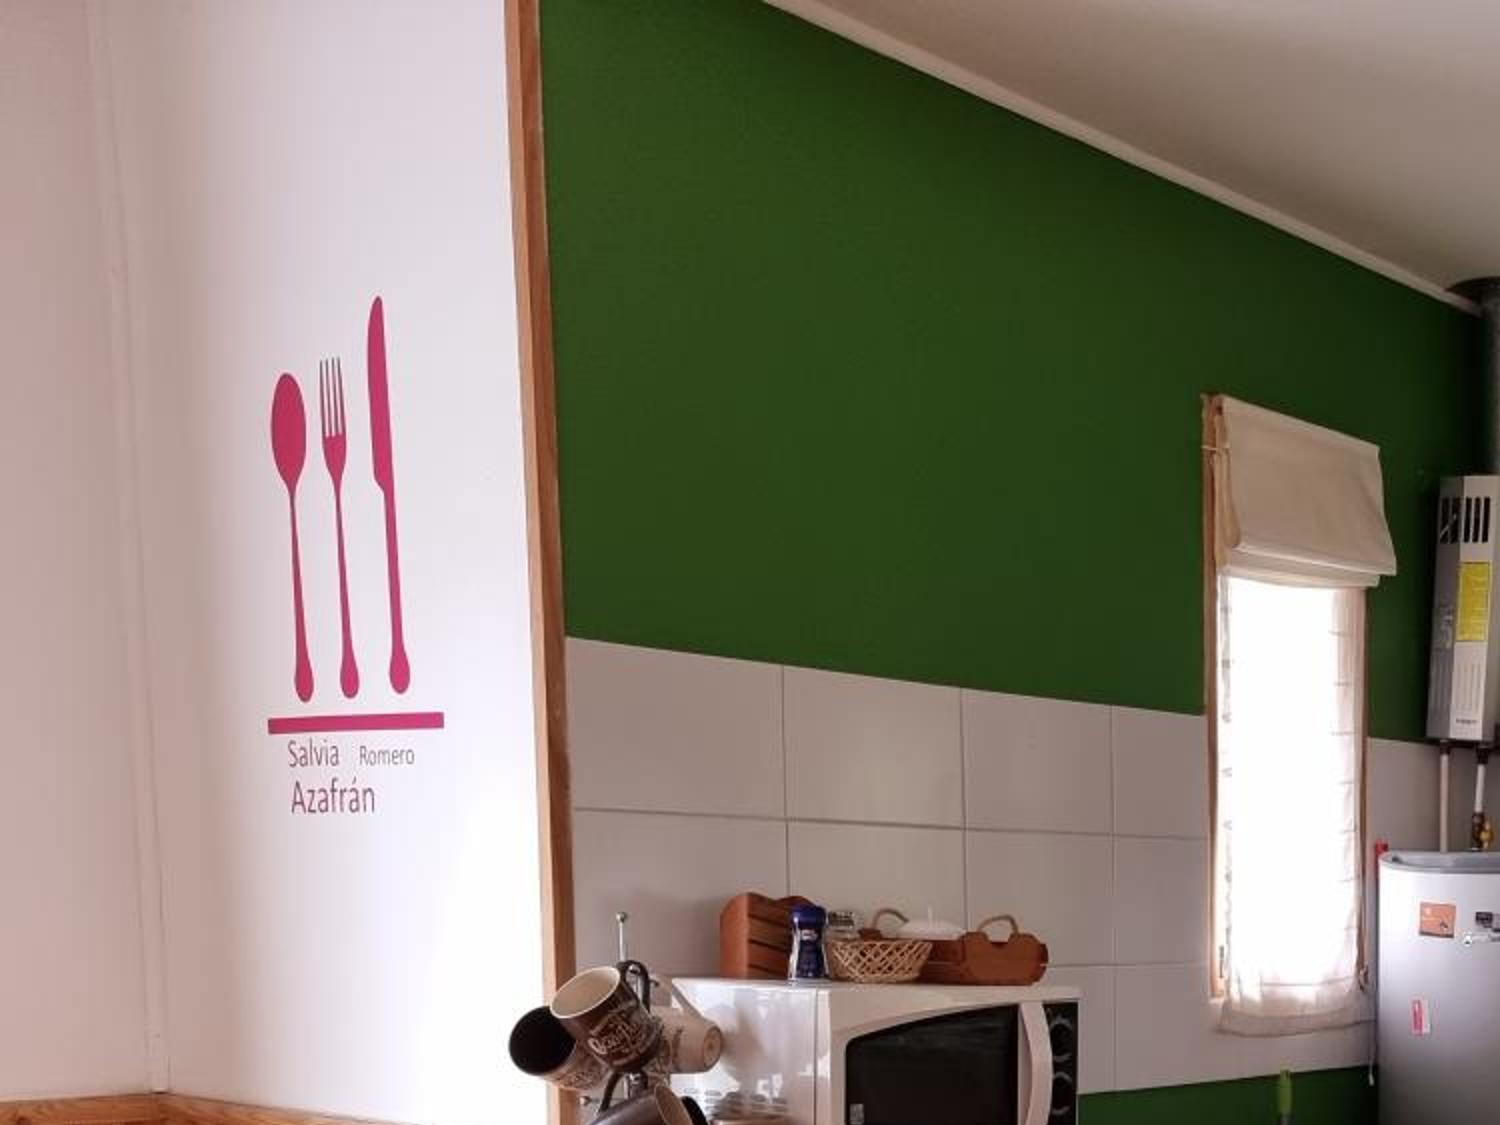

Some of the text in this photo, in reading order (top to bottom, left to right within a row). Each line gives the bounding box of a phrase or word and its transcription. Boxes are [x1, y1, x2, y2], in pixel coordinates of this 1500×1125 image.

[287, 738, 416, 768] Salvia Romero
[291, 776, 376, 814] Azafrán
